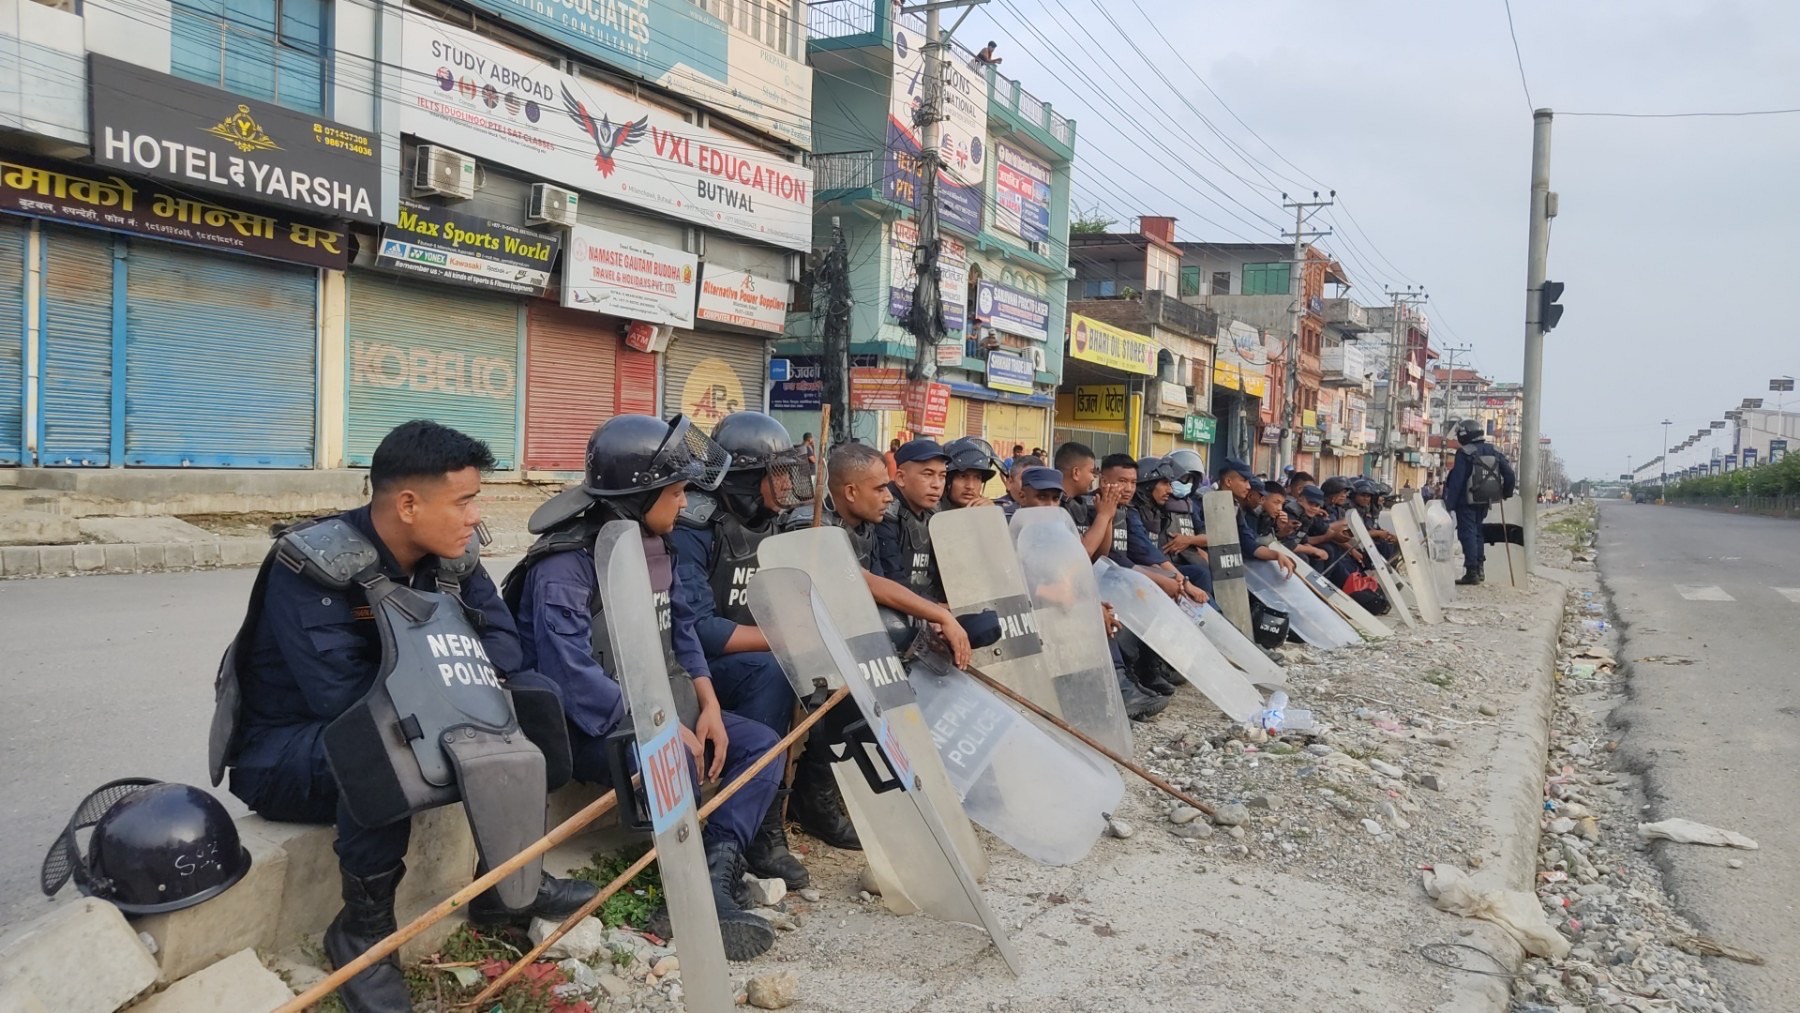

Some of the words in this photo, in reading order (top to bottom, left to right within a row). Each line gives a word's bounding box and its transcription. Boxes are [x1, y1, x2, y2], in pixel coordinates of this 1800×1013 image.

[549, 0, 650, 44] SOCIATES
[562, 13, 649, 61] CONSULTANCY
[432, 40, 485, 74] STUDY
[490, 64, 553, 101] ABROAD
[417, 97, 439, 113] IELTS
[104, 126, 228, 185] HOTEL
[248, 161, 374, 217] YARSHA
[652, 125, 694, 168] VXL
[698, 145, 806, 204] EDUCATION
[698, 179, 754, 213] BUTWAL
[896, 178, 914, 202] PTE
[0, 161, 138, 211] माको
[153, 193, 278, 239] भान्सा
[290, 222, 344, 254] घर
[397, 211, 440, 238] Max
[443, 222, 500, 250] Sports
[504, 235, 550, 262] World
[395, 260, 430, 273] Remember
[452, 272, 467, 281] kinds
[424, 253, 446, 264] YONEX
[450, 257, 482, 271] Kawasaki
[588, 246, 623, 267] NAMASTE
[624, 255, 652, 275] GAUTAM
[653, 262, 681, 280] BUDDHA
[592, 266, 615, 281] TRAVEL
[616, 271, 620, 281] &
[622, 274, 651, 288] HOLIDAYS
[703, 280, 738, 301] Alternative
[739, 289, 759, 306] Power
[759, 294, 785, 311] Suppliers
[630, 332, 649, 345] ATM
[1111, 336, 1120, 358] OIL
[1122, 339, 1146, 363] STORES
[1077, 387, 1098, 412] डिजल
[653, 589, 671, 607] PAL
[729, 589, 749, 606] PO
[658, 608, 671, 631] ICE
[999, 613, 1025, 641] PAL
[427, 634, 491, 663] NEPAL
[858, 657, 891, 688] PAL
[948, 704, 1004, 768] POLICE
